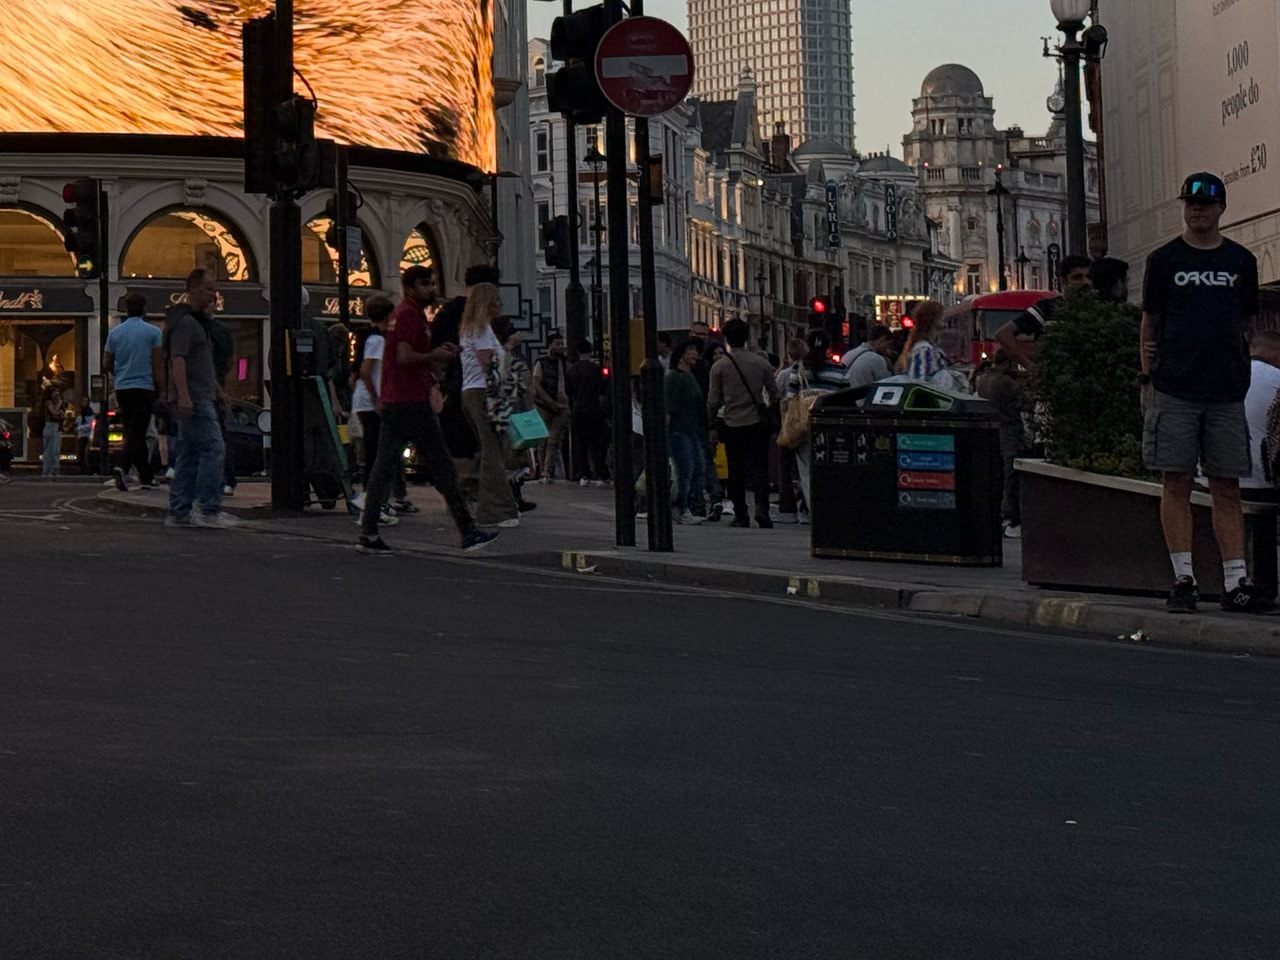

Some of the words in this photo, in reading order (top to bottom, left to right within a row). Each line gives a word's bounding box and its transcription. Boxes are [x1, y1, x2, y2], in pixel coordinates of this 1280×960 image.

[1221, 83, 1248, 127] people
[1248, 77, 1260, 105] do
[828, 191, 839, 243] LYRIC
[886, 187, 897, 240] APOLLO
[1173, 270, 1239, 288] OAKLEY
